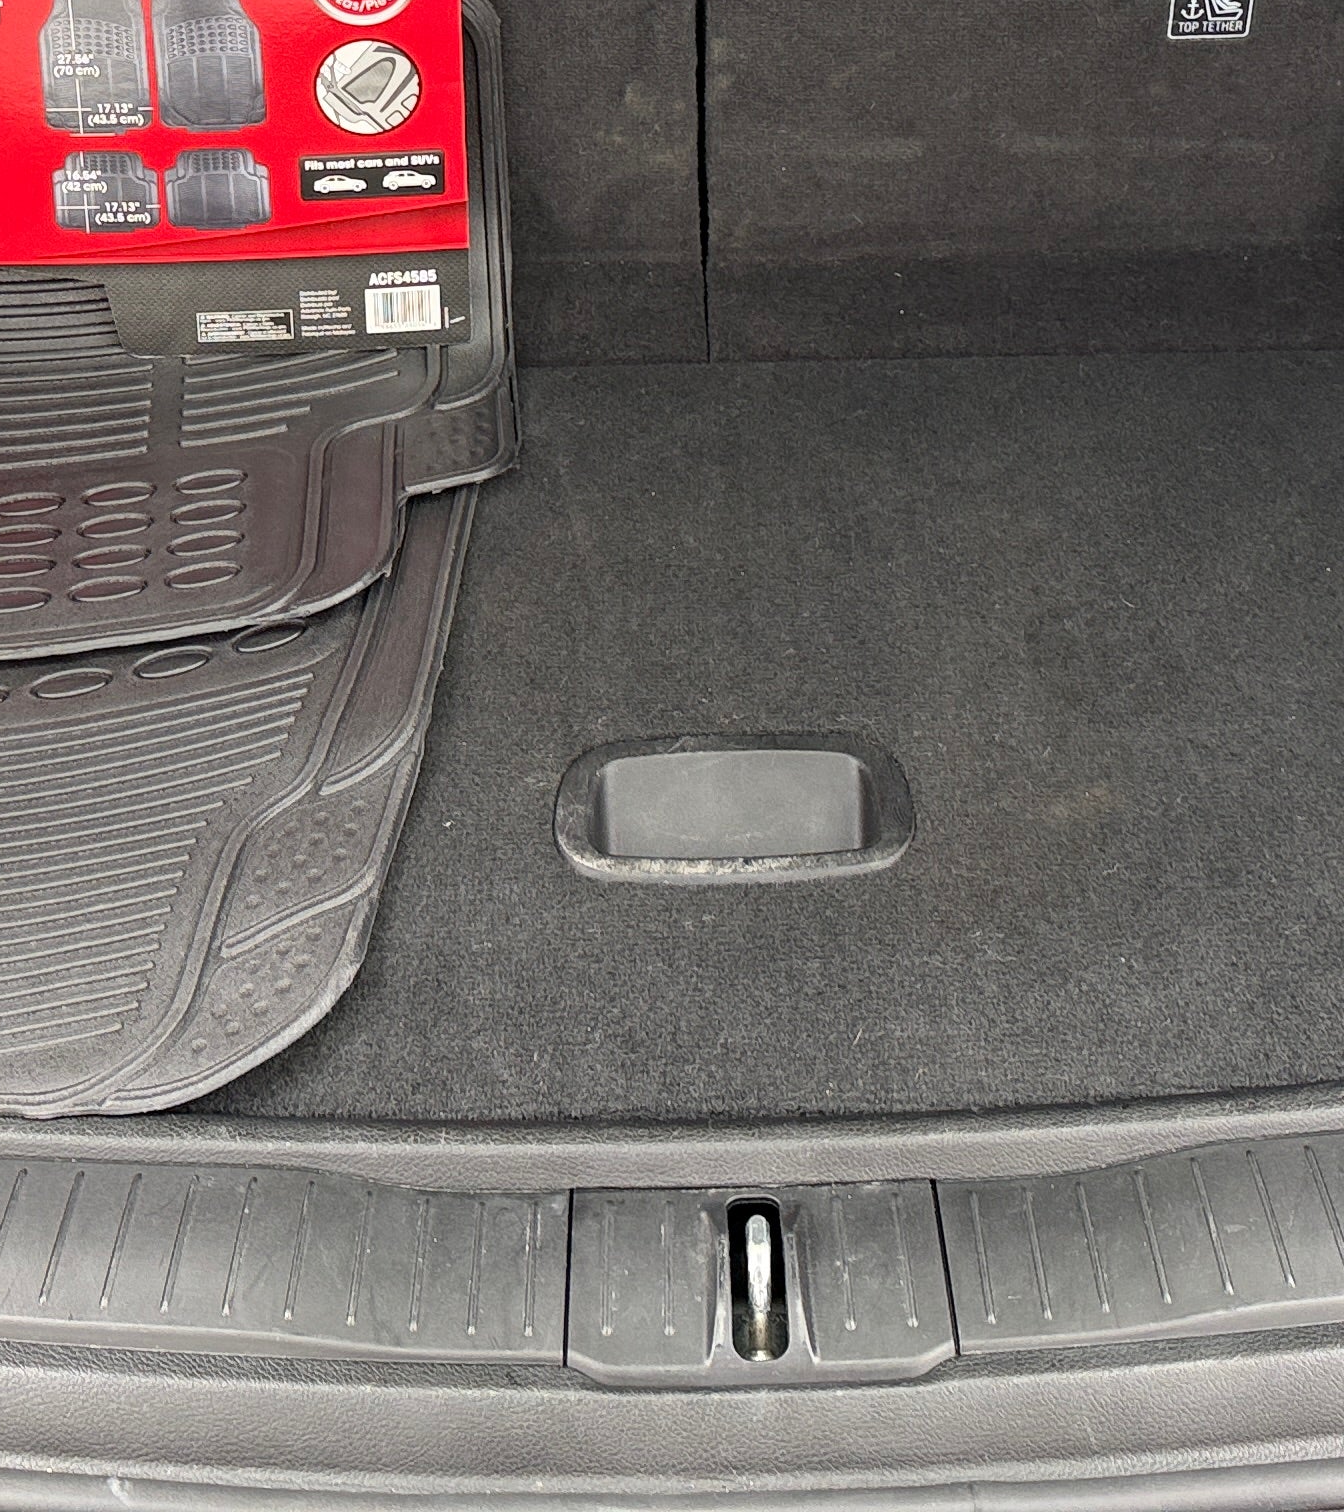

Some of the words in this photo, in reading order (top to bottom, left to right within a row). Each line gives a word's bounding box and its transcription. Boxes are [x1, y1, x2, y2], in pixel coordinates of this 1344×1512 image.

[1178, 21, 1200, 33] TOP
[1202, 20, 1244, 33] TETHER
[75, 65, 100, 78] cm)
[119, 114, 144, 126] cm)
[326, 158, 355, 170] most
[357, 157, 384, 168] cars
[385, 156, 409, 167] and
[410, 154, 440, 166] SUVs
[62, 181, 81, 193] (42
[83, 181, 107, 193] cm)
[127, 212, 152, 225] cm)
